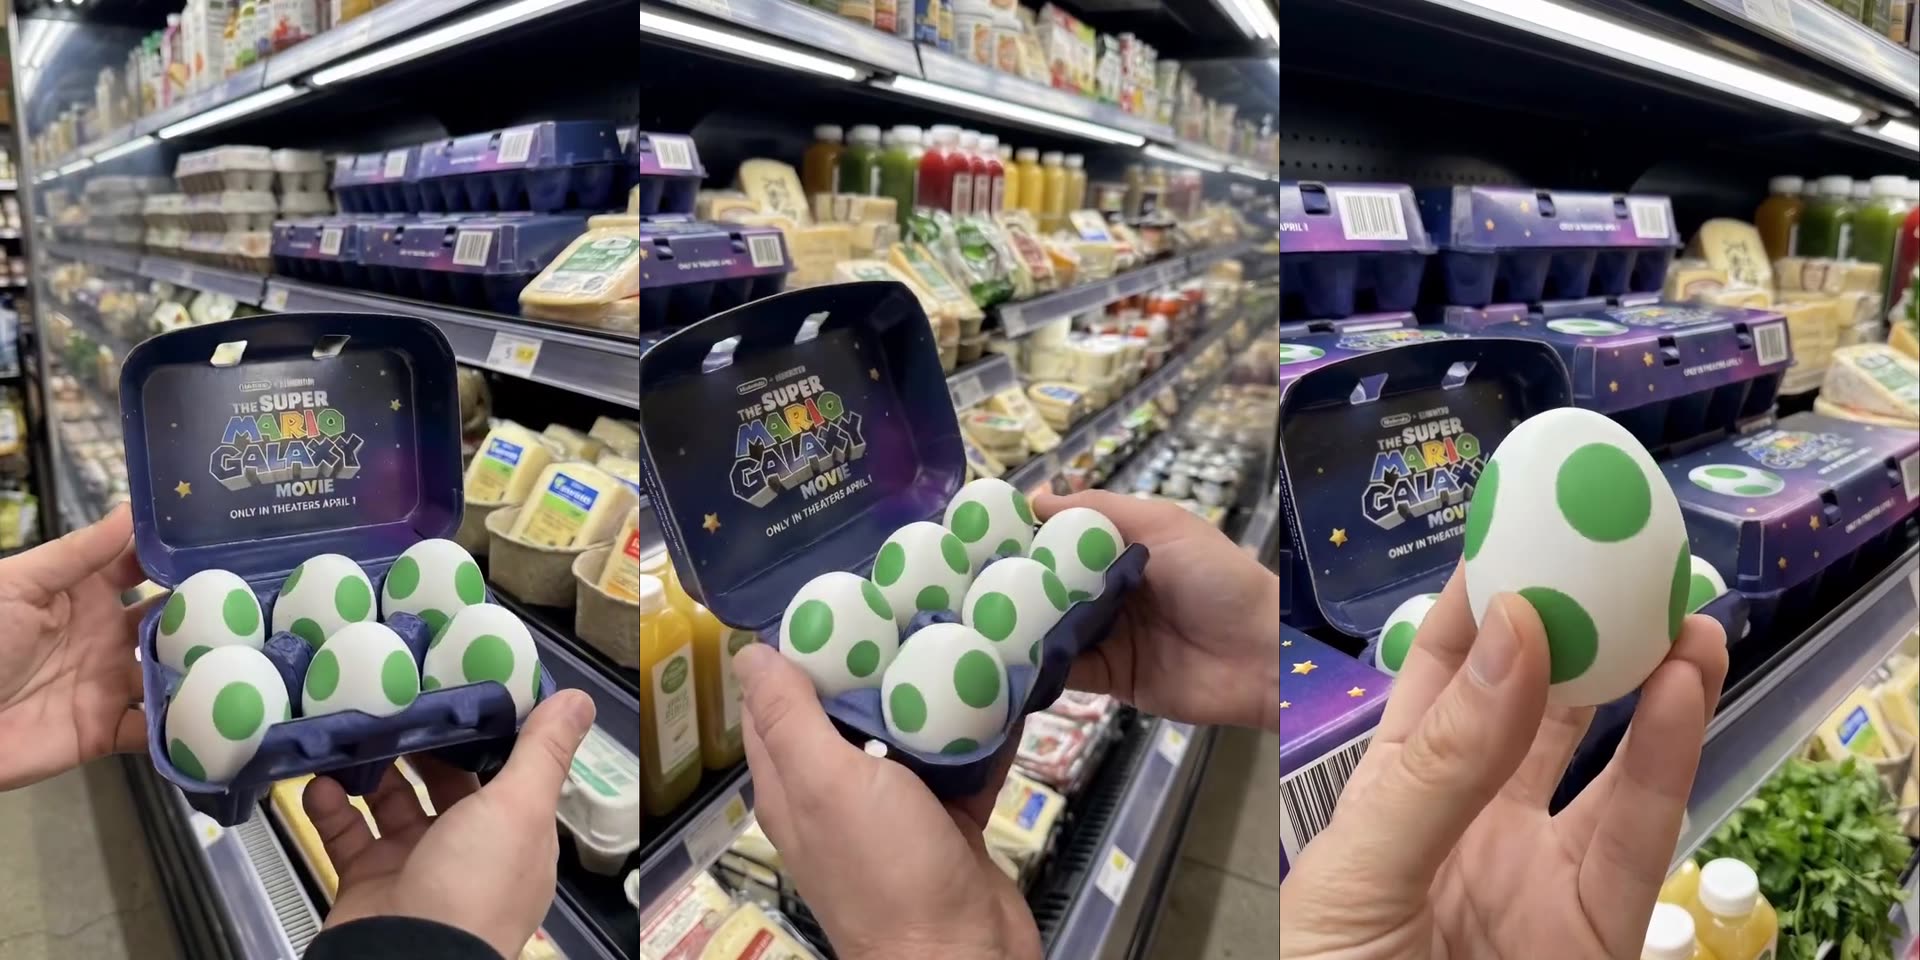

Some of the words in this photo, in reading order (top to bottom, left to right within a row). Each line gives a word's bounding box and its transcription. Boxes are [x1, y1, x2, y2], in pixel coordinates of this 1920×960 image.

[1280, 222, 1303, 231] APRIL
[233, 402, 258, 414] THE
[259, 390, 329, 413] SUPER
[737, 403, 763, 422] THE
[761, 375, 825, 413] SUPER
[221, 408, 345, 444] MARIO
[736, 391, 844, 458] MARIO
[1377, 436, 1402, 450] THE
[1402, 417, 1464, 445] SUPER
[209, 433, 364, 488] GALAXY
[729, 411, 866, 505] GALAXY
[1370, 432, 1481, 483] MARIO
[276, 479, 334, 498] MOVIE
[800, 462, 851, 500] MOVIE
[230, 507, 256, 519] ONLY
[259, 505, 270, 516] IN
[272, 499, 320, 514] THEATERS
[323, 498, 350, 509] APRIL
[352, 496, 357, 505] 1
[766, 519, 791, 537] ONLY
[792, 512, 802, 525] IN
[802, 488, 845, 518] THEATERS
[846, 480, 868, 496] APRIL
[868, 474, 873, 483] 1
[1427, 502, 1469, 528] MOV
[1388, 544, 1414, 559] ONLY
[1415, 538, 1427, 549] IN
[1426, 524, 1466, 545] THEATER
